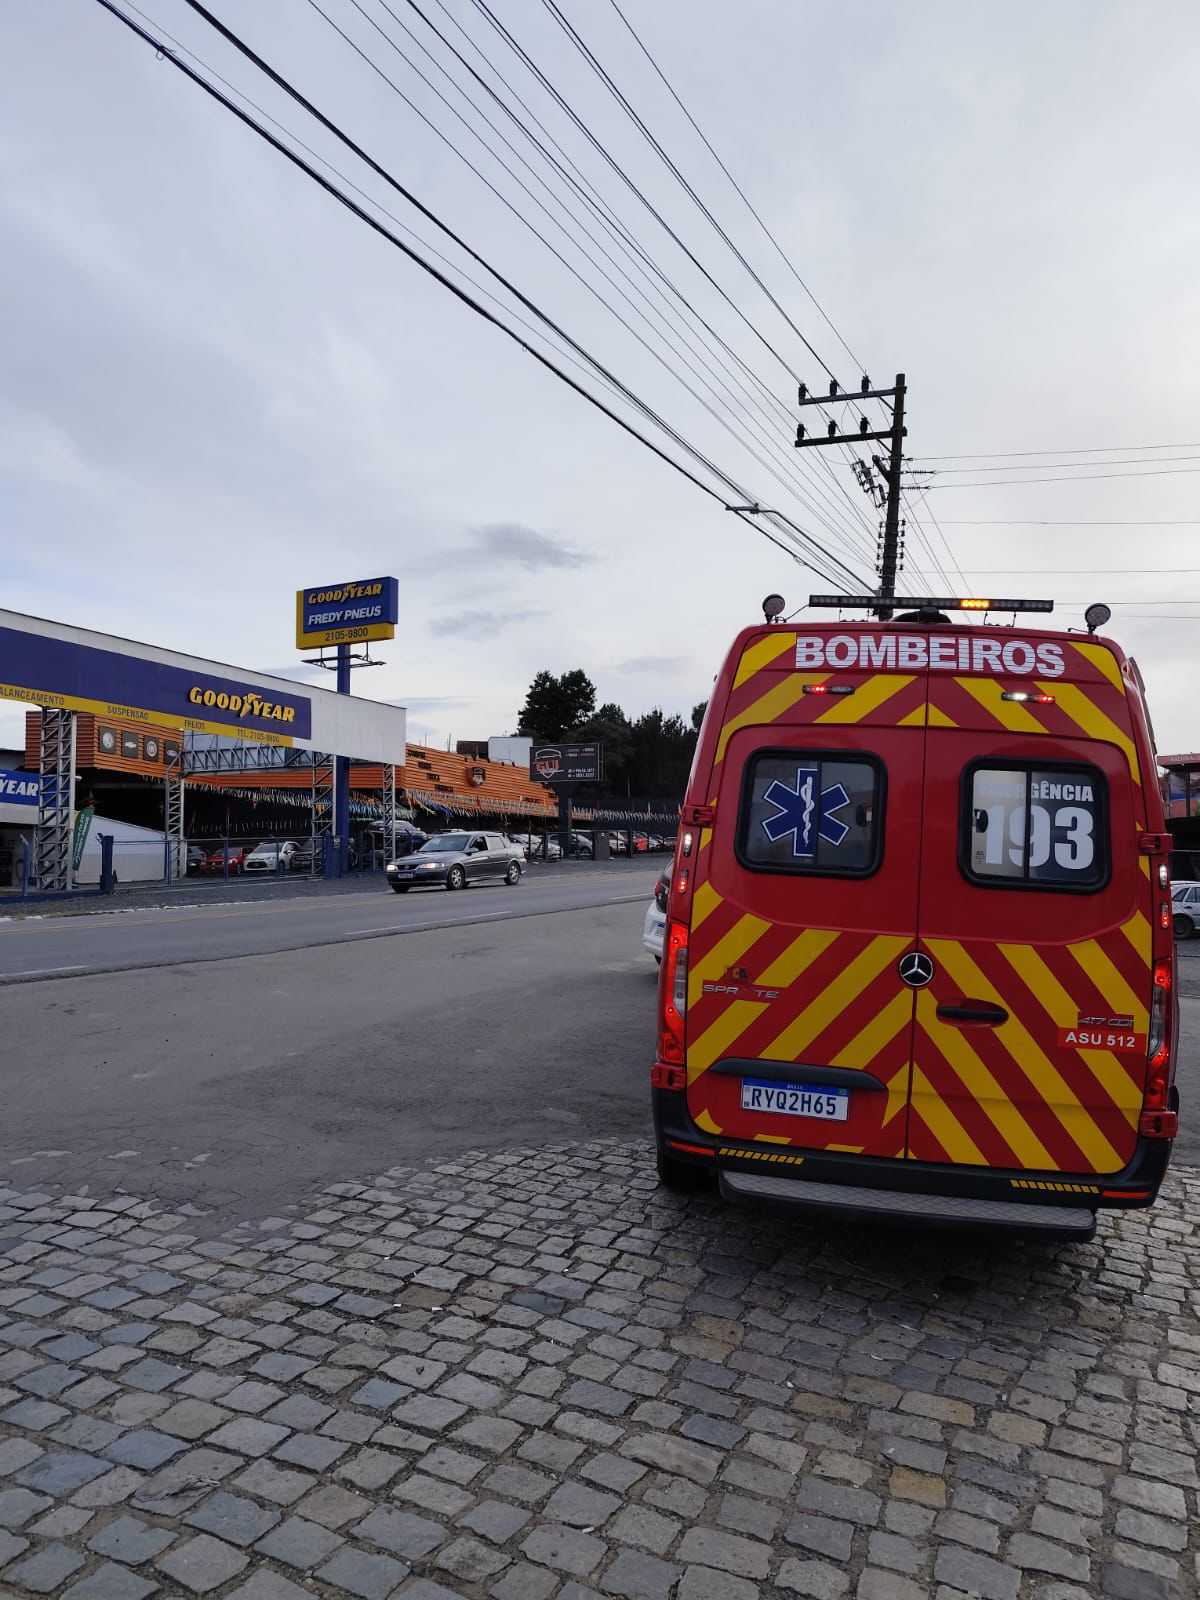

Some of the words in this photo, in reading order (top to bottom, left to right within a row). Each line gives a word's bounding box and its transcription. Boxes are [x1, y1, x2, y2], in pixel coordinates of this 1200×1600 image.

[308, 584, 383, 604] GOODYEAR
[308, 611, 344, 625] FREDY
[344, 606, 382, 620] PNEUS
[325, 627, 369, 641] 2105-9800
[795, 635, 1065, 677] BOMBEIROS
[189, 686, 296, 722] GOODYEAR
[986, 804, 1094, 870] 193
[1065, 1031, 1102, 1045] ASU
[1107, 1035, 1136, 1048] 512
[751, 1087, 837, 1116] RYQ2H65
